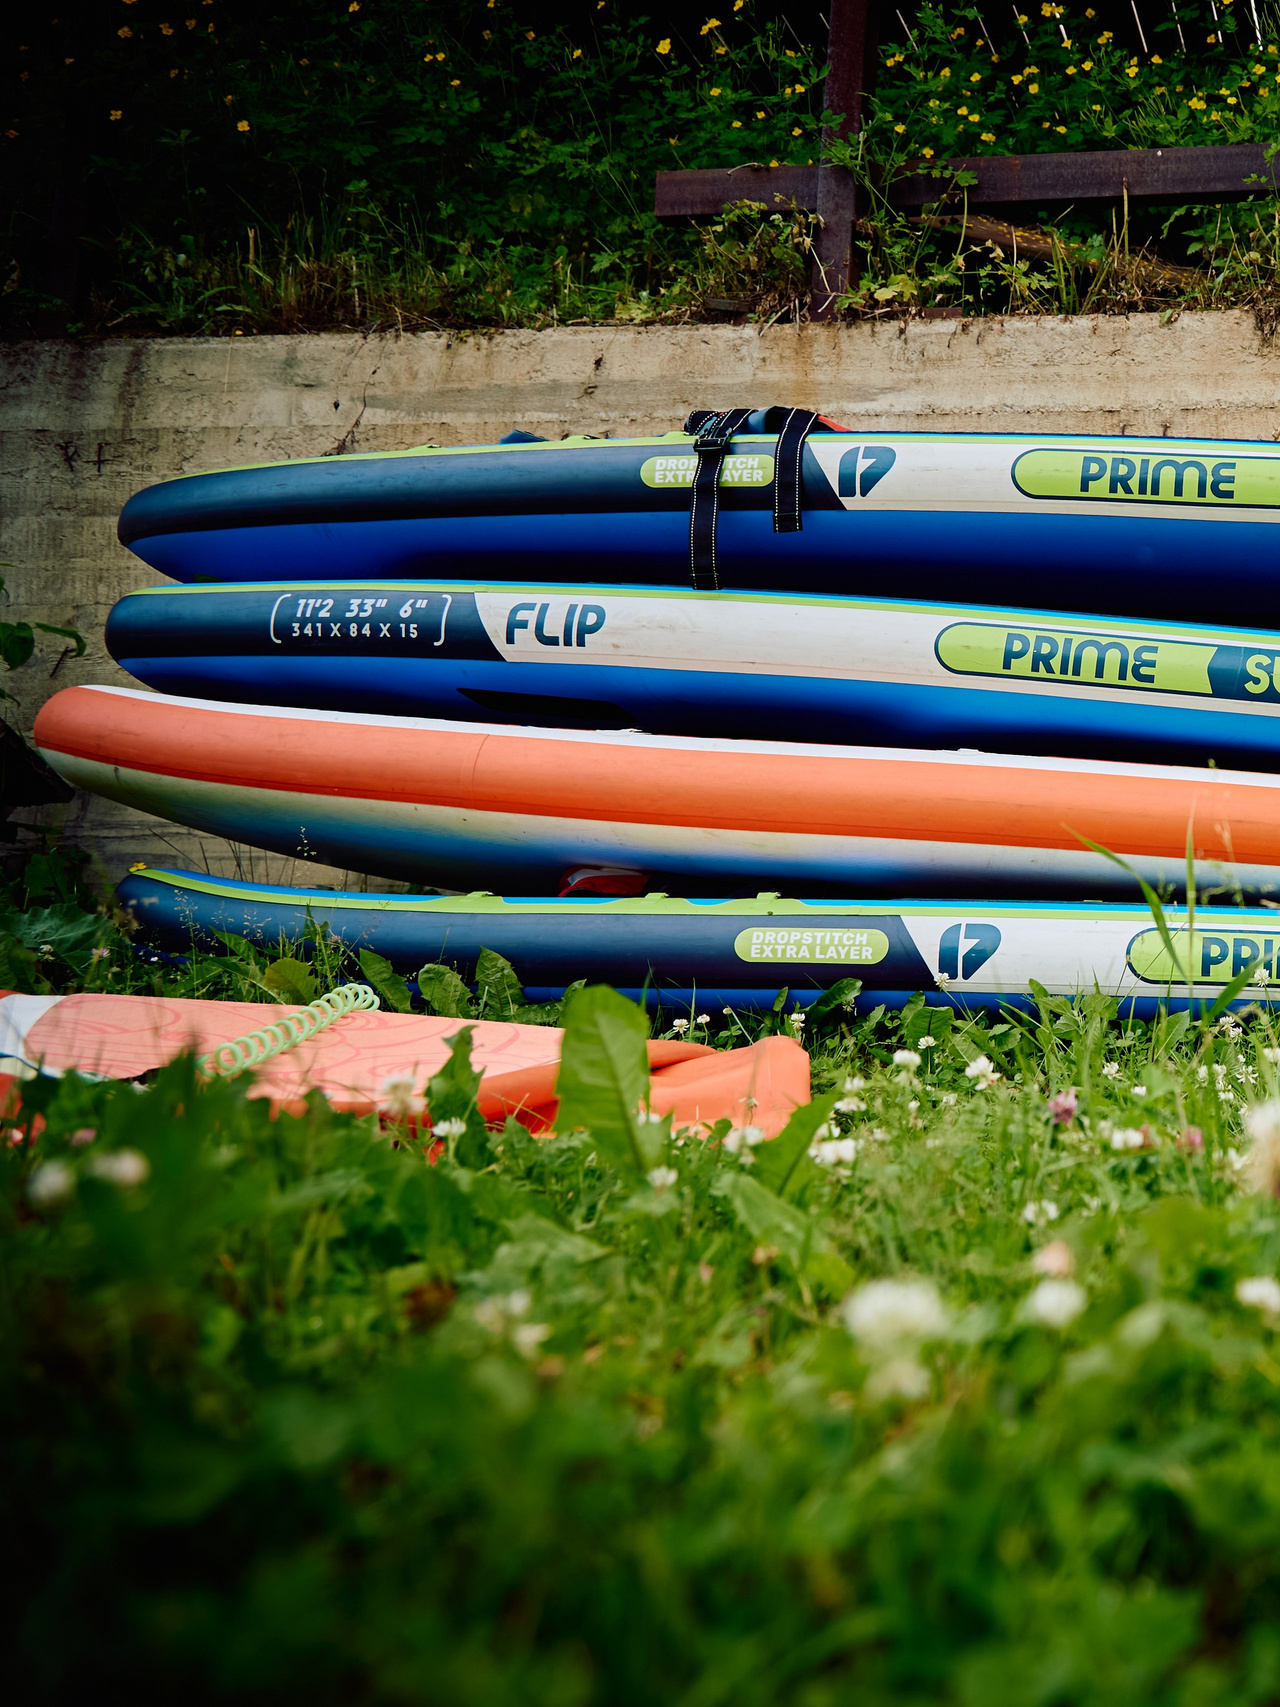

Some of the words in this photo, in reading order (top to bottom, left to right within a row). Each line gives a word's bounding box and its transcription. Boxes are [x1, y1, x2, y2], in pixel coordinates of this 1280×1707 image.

[655, 457, 759, 471] DROPTCH
[654, 470, 696, 483] EXTR
[719, 469, 763, 482] AYER
[1080, 456, 1236, 499] PRIME
[292, 622, 322, 637] 341
[330, 622, 341, 637] X
[349, 622, 371, 638] 84
[379, 623, 391, 638] X
[400, 623, 418, 639] 15
[505, 602, 606, 647] FLIP
[1002, 632, 1159, 684] PRIME
[751, 931, 868, 946] DROPSTITCH
[750, 944, 810, 959] EXTRA
[815, 945, 874, 960] LAYER
